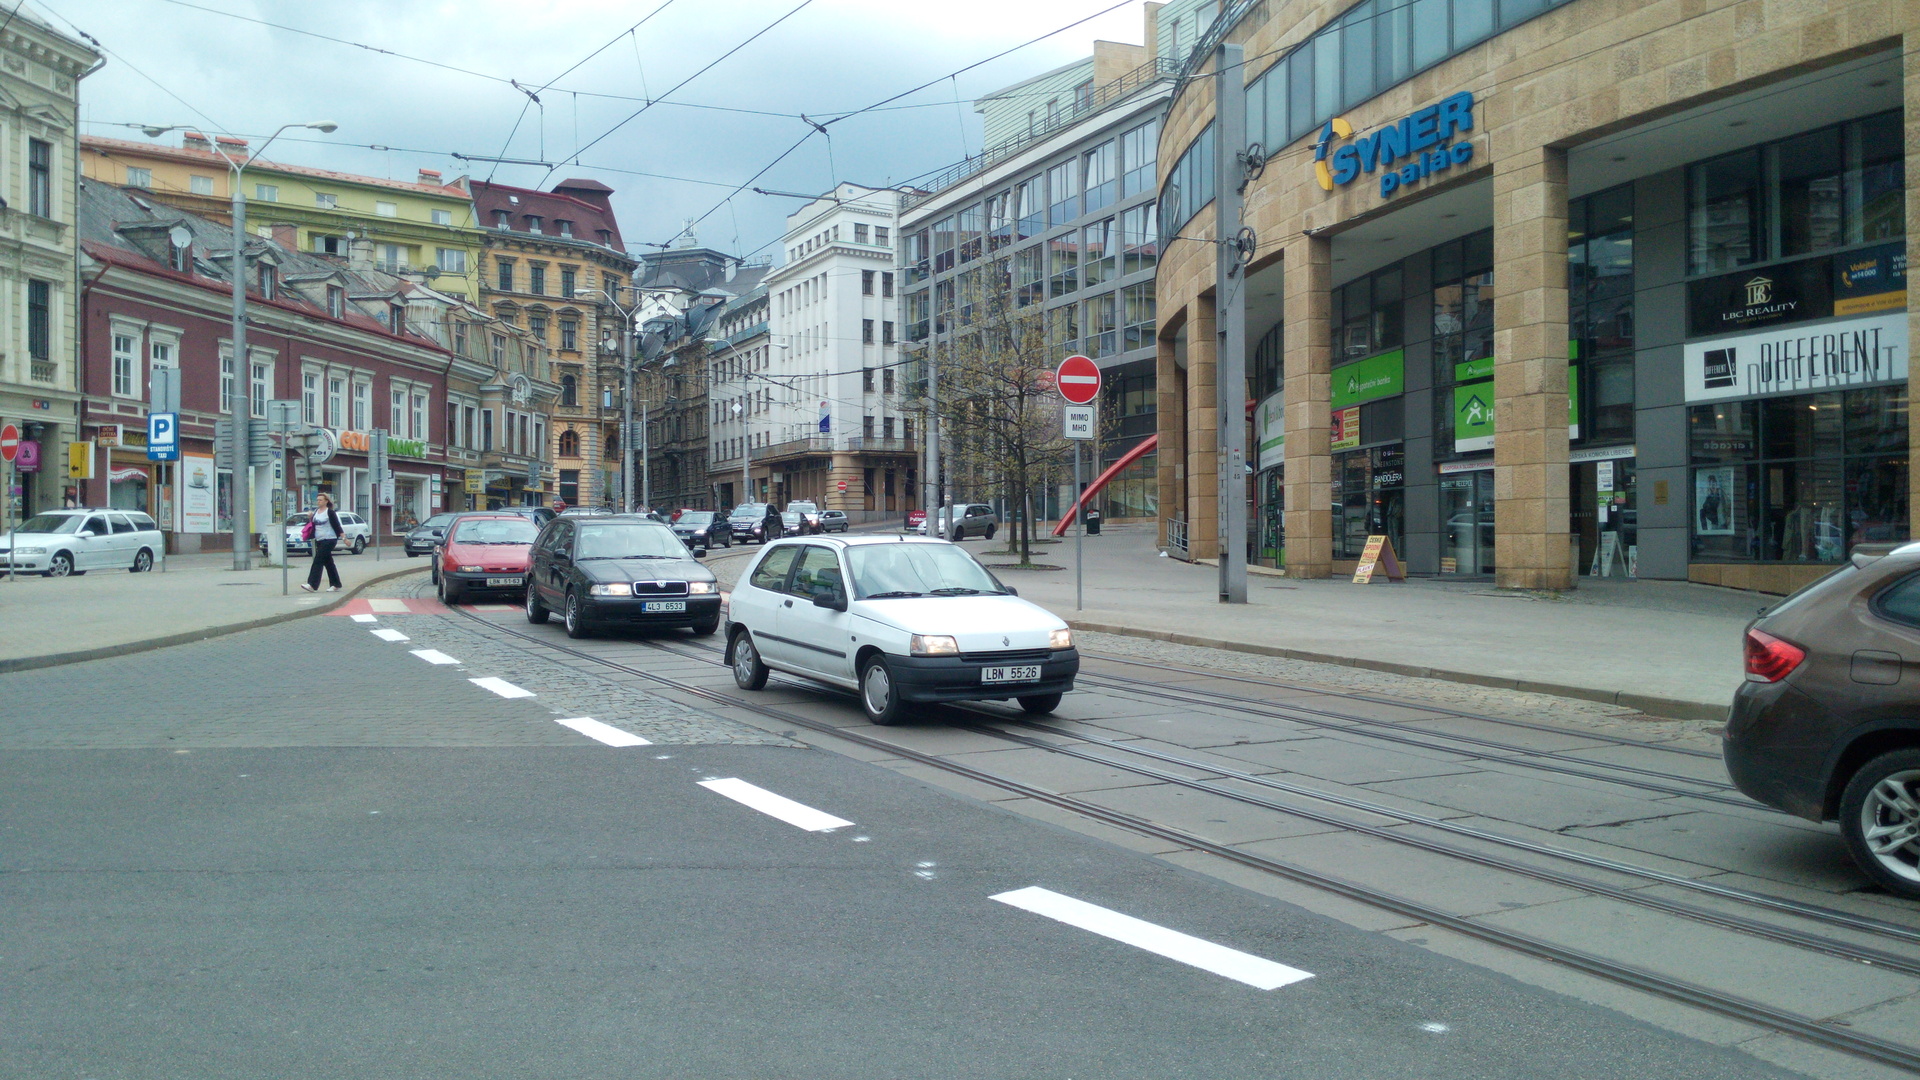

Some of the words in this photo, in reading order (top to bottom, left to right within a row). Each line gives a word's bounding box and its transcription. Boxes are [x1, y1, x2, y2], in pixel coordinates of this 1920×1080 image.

[1333, 91, 1474, 186] SYNER
[1380, 141, 1474, 198] palác
[1722, 311, 1744, 321] LBC
[1746, 301, 1797, 317] REALITY
[1761, 327, 1883, 383] DIFFERENT
[1071, 413, 1089, 422] MIMO
[153, 418, 170, 440] P
[1072, 424, 1087, 432] MHD
[387, 438, 426, 458] INANCE
[1611, 448, 1632, 456] LIBEREC
[1374, 473, 1403, 484] BANDOLERA
[647, 603, 661, 611] 4L3
[665, 602, 683, 610] 6533
[986, 668, 1004, 680] LBN
[1010, 666, 1037, 679] 55-26
